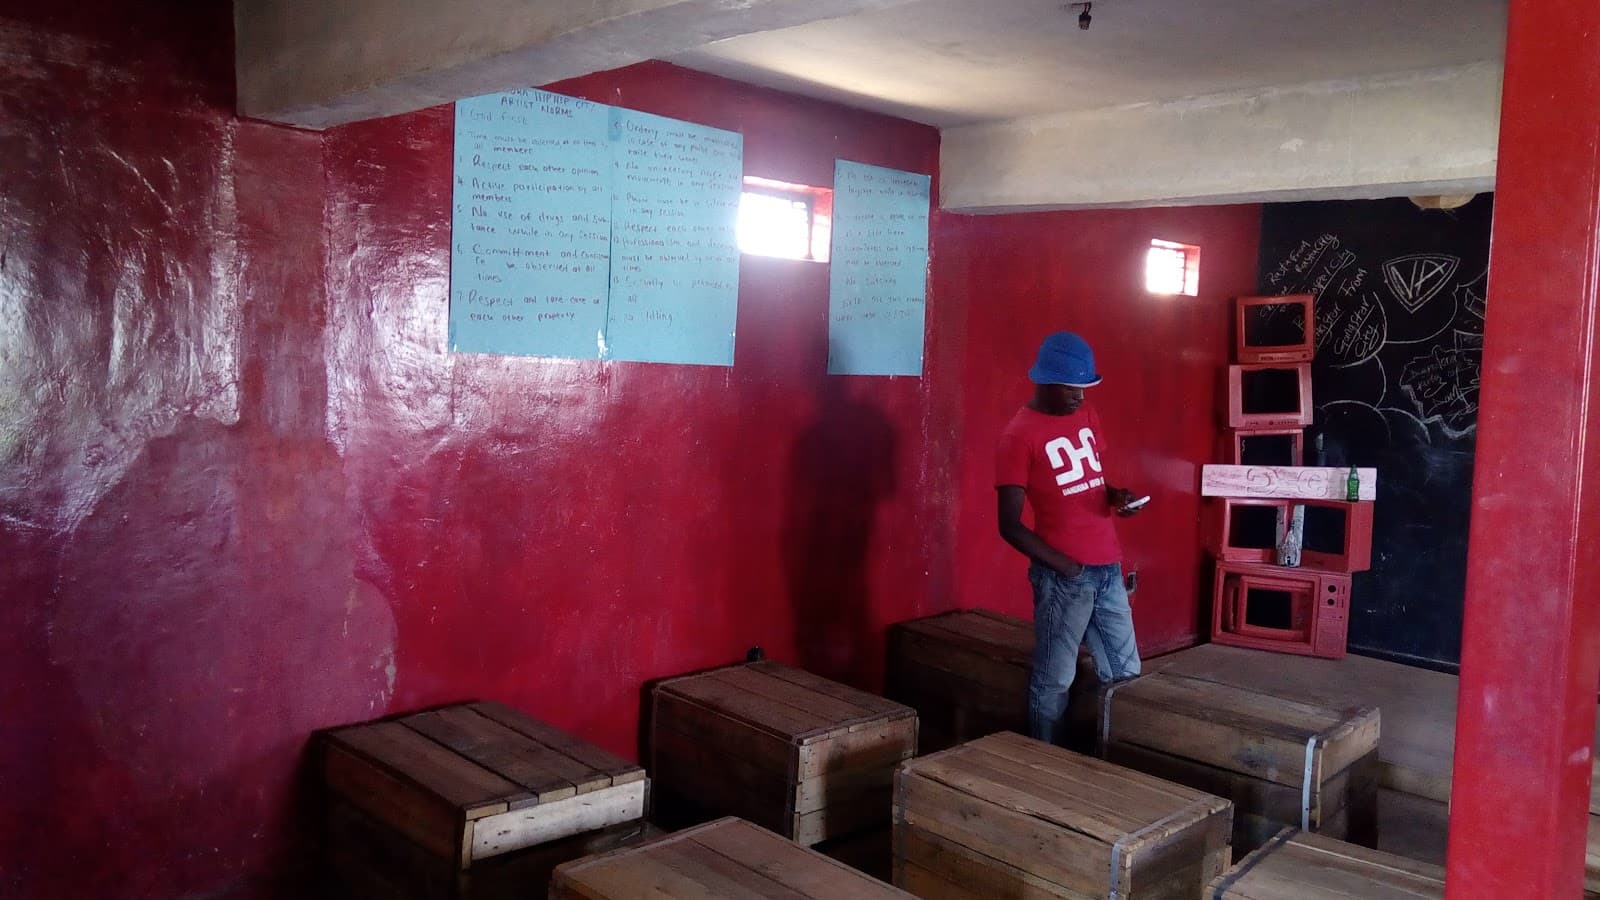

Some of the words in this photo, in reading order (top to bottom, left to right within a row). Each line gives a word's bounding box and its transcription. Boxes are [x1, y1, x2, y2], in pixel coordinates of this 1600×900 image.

[493, 146, 534, 155] members
[472, 153, 512, 171] Respect
[472, 177, 505, 191] Active
[513, 182, 575, 194] participation
[472, 194, 513, 203] members
[471, 205, 489, 218] No
[497, 209, 513, 221] use
[520, 211, 532, 221] of
[538, 211, 564, 225] drugs
[525, 261, 569, 273] observed
[469, 288, 514, 308] Respect
